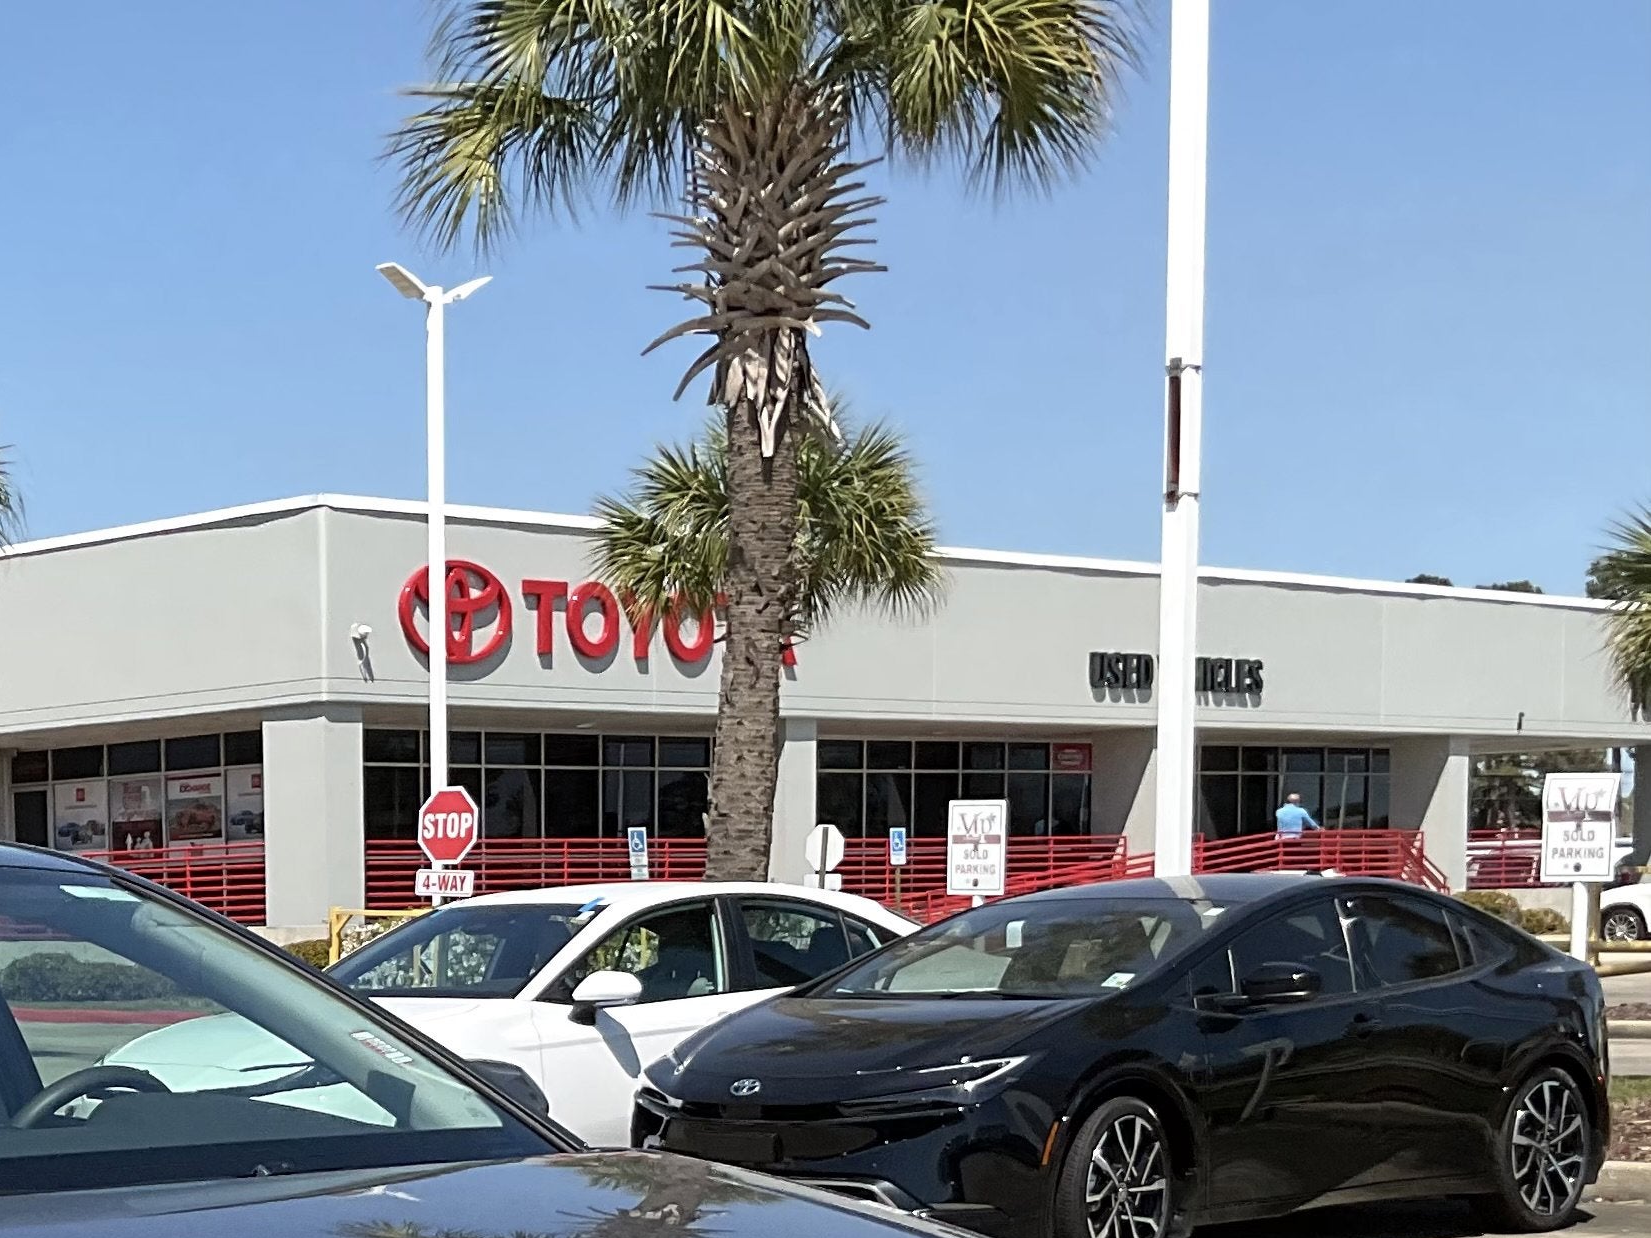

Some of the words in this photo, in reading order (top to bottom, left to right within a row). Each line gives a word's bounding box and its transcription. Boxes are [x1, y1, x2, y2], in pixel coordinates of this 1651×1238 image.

[521, 579, 798, 667] TOYO
[1089, 652, 1154, 689] USED
[422, 812, 473, 839] STOP
[1563, 829, 1596, 842] SOLD
[963, 849, 989, 860] SOLD
[1551, 847, 1605, 859] PARKING
[955, 863, 996, 875] PARKING
[422, 874, 467, 892] 4-WAY
